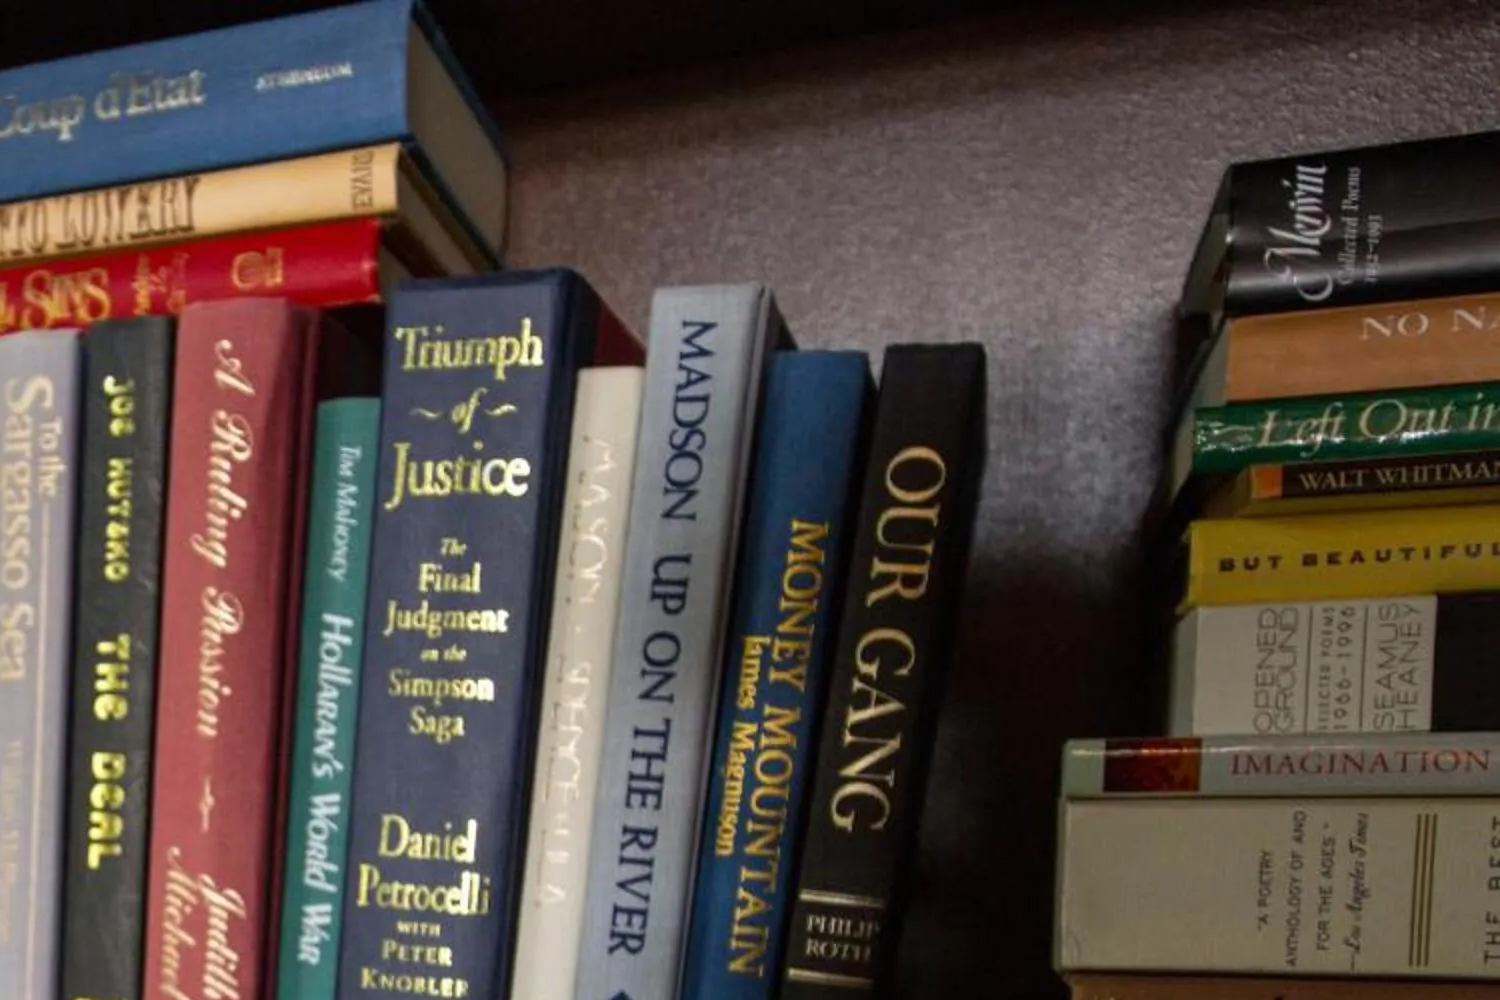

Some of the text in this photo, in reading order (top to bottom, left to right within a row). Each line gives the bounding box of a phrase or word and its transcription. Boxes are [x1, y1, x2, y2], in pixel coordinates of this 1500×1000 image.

[1337, 166, 1362, 286] Collected Poems
[394, 317, 544, 382] Triumph
[1359, 311, 1430, 341] NO
[450, 386, 488, 435] of
[1257, 402, 1348, 459] Left
[1358, 398, 1457, 445] Out
[0, 374, 55, 590] Sargasso
[188, 409, 254, 569] Ruling
[383, 441, 532, 510] Justice
[1299, 470, 1371, 492] WALT
[439, 537, 468, 558] The
[1218, 554, 1284, 574] BUT
[418, 562, 482, 594] Final
[383, 600, 510, 640] Judgment
[606, 319, 720, 958] MADSON UP ON THE RIVER
[828, 445, 948, 835] OUR GANG
[195, 586, 244, 739] Passion
[420, 643, 468, 663] on the
[1252, 607, 1279, 733] OPENED
[1272, 605, 1301, 734] GROUND
[1373, 601, 1399, 731] SEAMUS
[1396, 603, 1423, 733] HEANEY
[387, 668, 495, 708] Simpson
[408, 706, 468, 746] Saga
[714, 634, 772, 858] James Magnuson
[725, 518, 831, 978] MONEY MOUNTAIN
[1230, 748, 1490, 777] IMAGINATION
[378, 812, 478, 863] Daniel
[356, 863, 491, 917] Petrocelli
[1257, 849, 1275, 910] POETRY
[1285, 810, 1308, 968] ANTHOLOGY OF AND
[1318, 884, 1334, 917] THE
[381, 939, 454, 967] PETER
[396, 919, 442, 937] WITH
[805, 938, 873, 963] ROTH
[1316, 921, 1332, 951] FOR
[360, 967, 470, 999] KNOBLER
